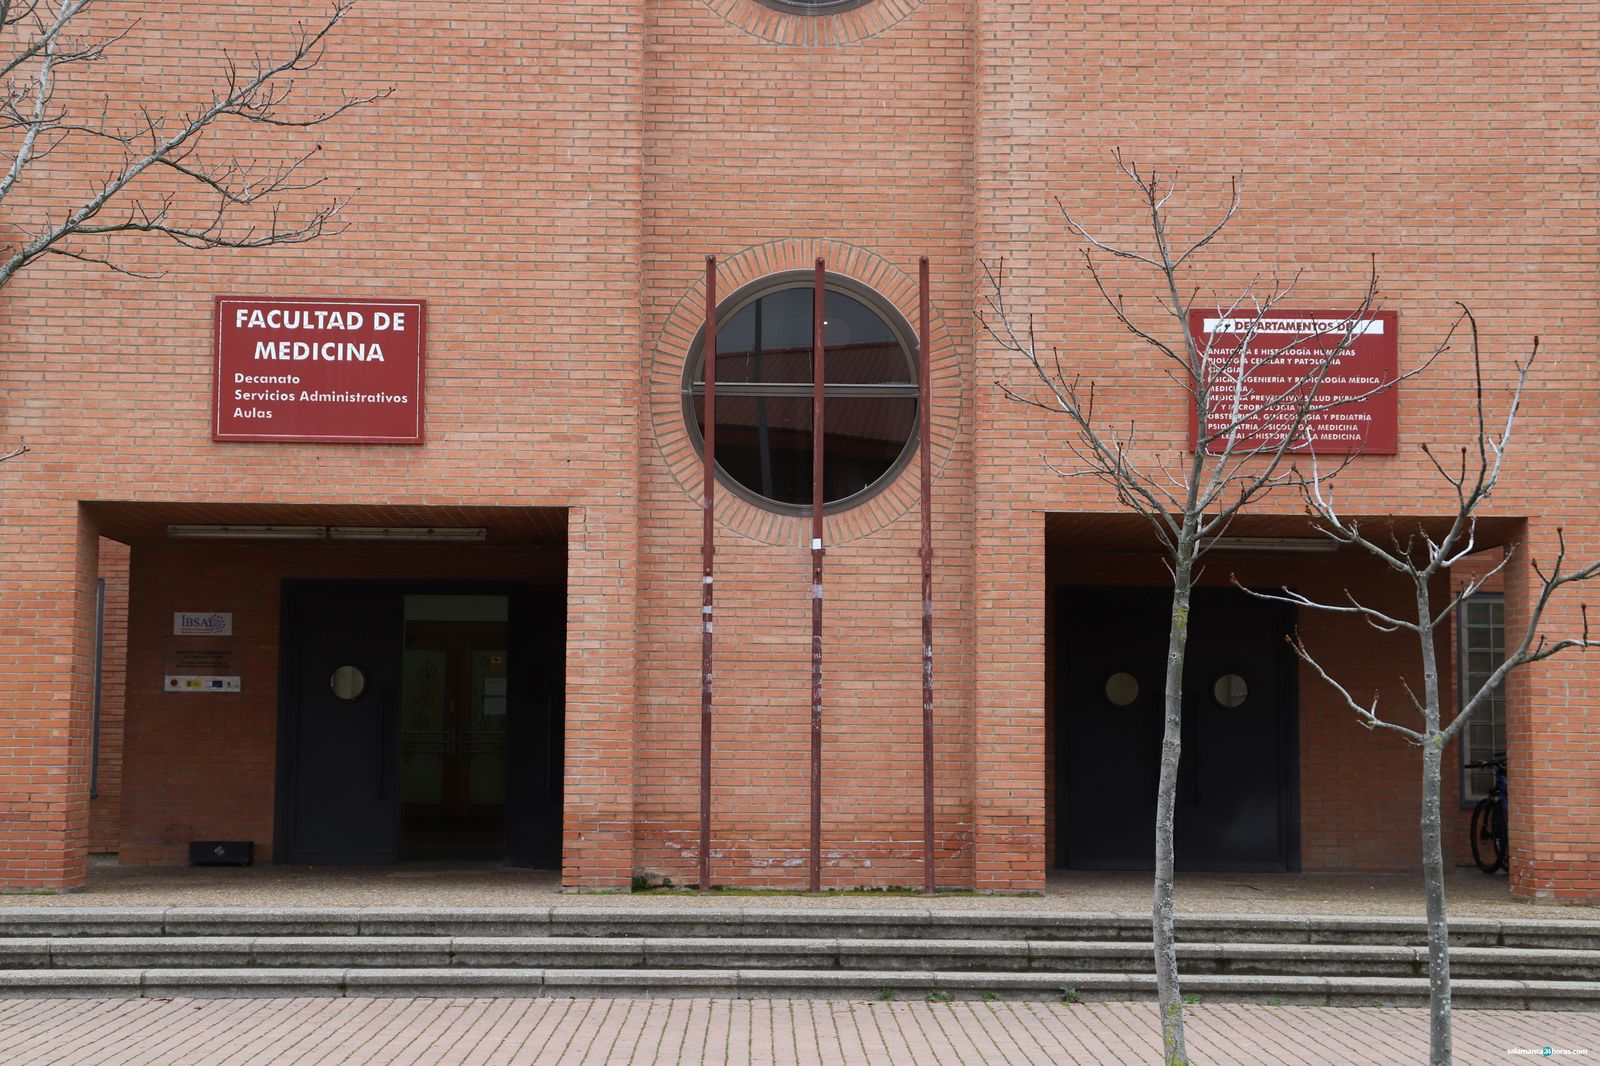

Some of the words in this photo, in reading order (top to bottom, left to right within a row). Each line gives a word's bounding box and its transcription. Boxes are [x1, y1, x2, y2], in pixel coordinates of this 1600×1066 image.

[235, 309, 364, 330] FACULTAD
[373, 311, 405, 331] DE
[1234, 321, 1334, 332] DEARTAMENTOS
[253, 341, 385, 362] MEDICINA
[1208, 357, 1248, 365] BIOLGA
[1250, 357, 1287, 365] CELLAR
[234, 373, 301, 384] Decanato
[1208, 376, 1235, 384] SICA,
[1237, 375, 1285, 384] GENIERÍA
[1348, 374, 1380, 384] MÉDICA
[234, 389, 296, 401] Servicios
[299, 390, 408, 404] Administrativos
[233, 407, 273, 419] Aulas
[1208, 413, 1260, 421] OBSTERIIA,
[1330, 412, 1372, 421] PEDIATRÍA
[1208, 422, 1258, 430] PSIQATRÍA
